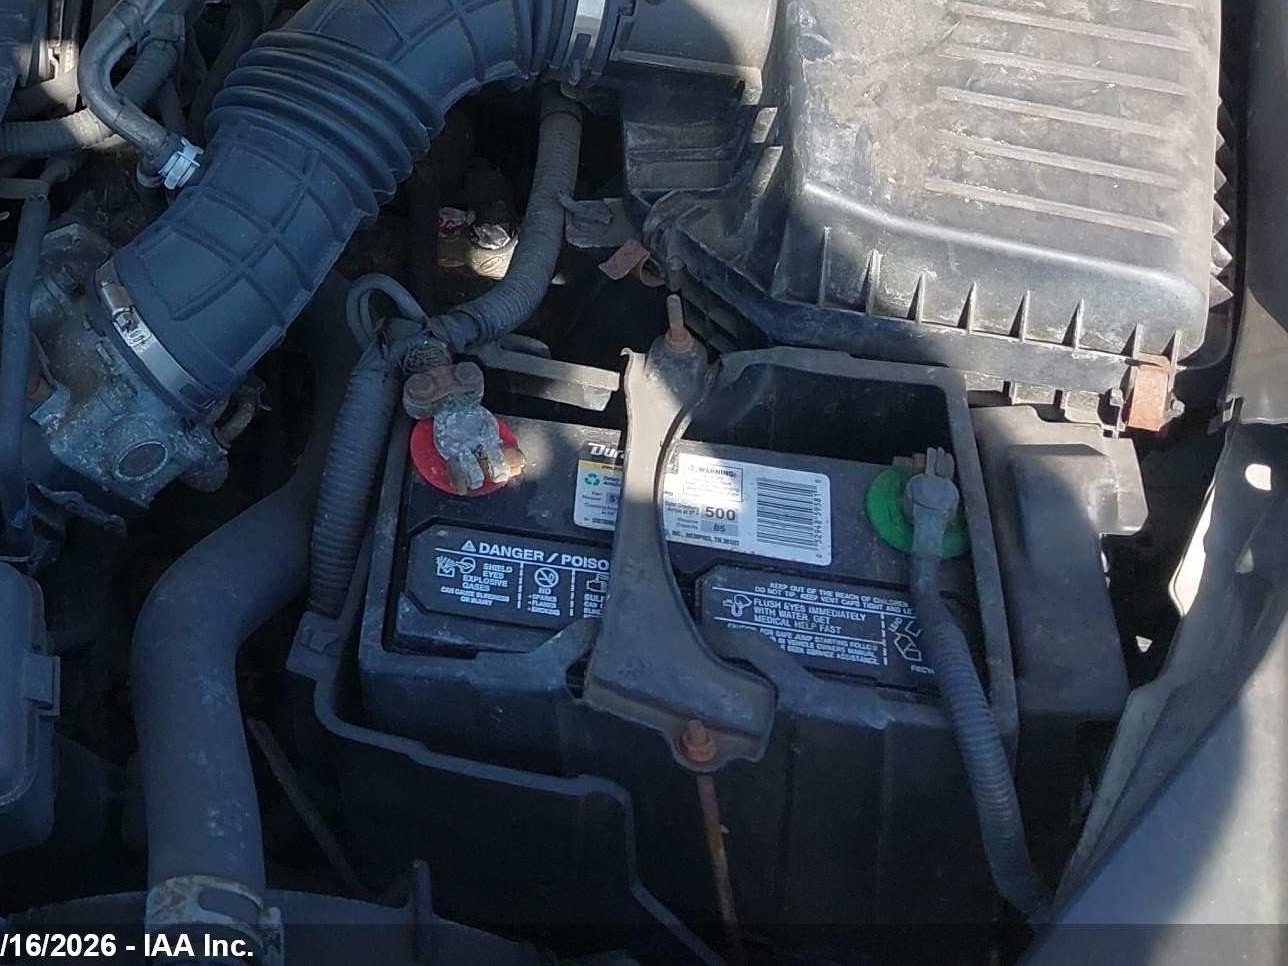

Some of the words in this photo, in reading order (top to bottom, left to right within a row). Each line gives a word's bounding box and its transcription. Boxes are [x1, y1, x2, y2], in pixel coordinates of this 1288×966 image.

[588, 442, 624, 459] Dur
[705, 506, 736, 521] 500
[479, 542, 544, 561] DANGER
[561, 554, 610, 571] POISO
[483, 563, 513, 573] SHIELD
[483, 570, 504, 579] EYES
[462, 582, 490, 591] GASES
[463, 575, 508, 587] EXPLOSIVE
[770, 582, 788, 590] KEEP
[790, 585, 804, 593] OUT
[819, 589, 833, 597] THE
[835, 591, 859, 601] REACH
[753, 598, 781, 609] FLUSH
[784, 602, 806, 613] EYES
[808, 606, 866, 621] IMMEDIATELY
[820, 596, 839, 604] VENT
[863, 601, 883, 610] TIGHT
[886, 605, 901, 613] AND
[754, 606, 776, 616] WITH
[813, 615, 831, 624] GET
[754, 614, 792, 627] MEDICAL
[794, 620, 817, 630] HELP
[819, 624, 842, 634] FAST
